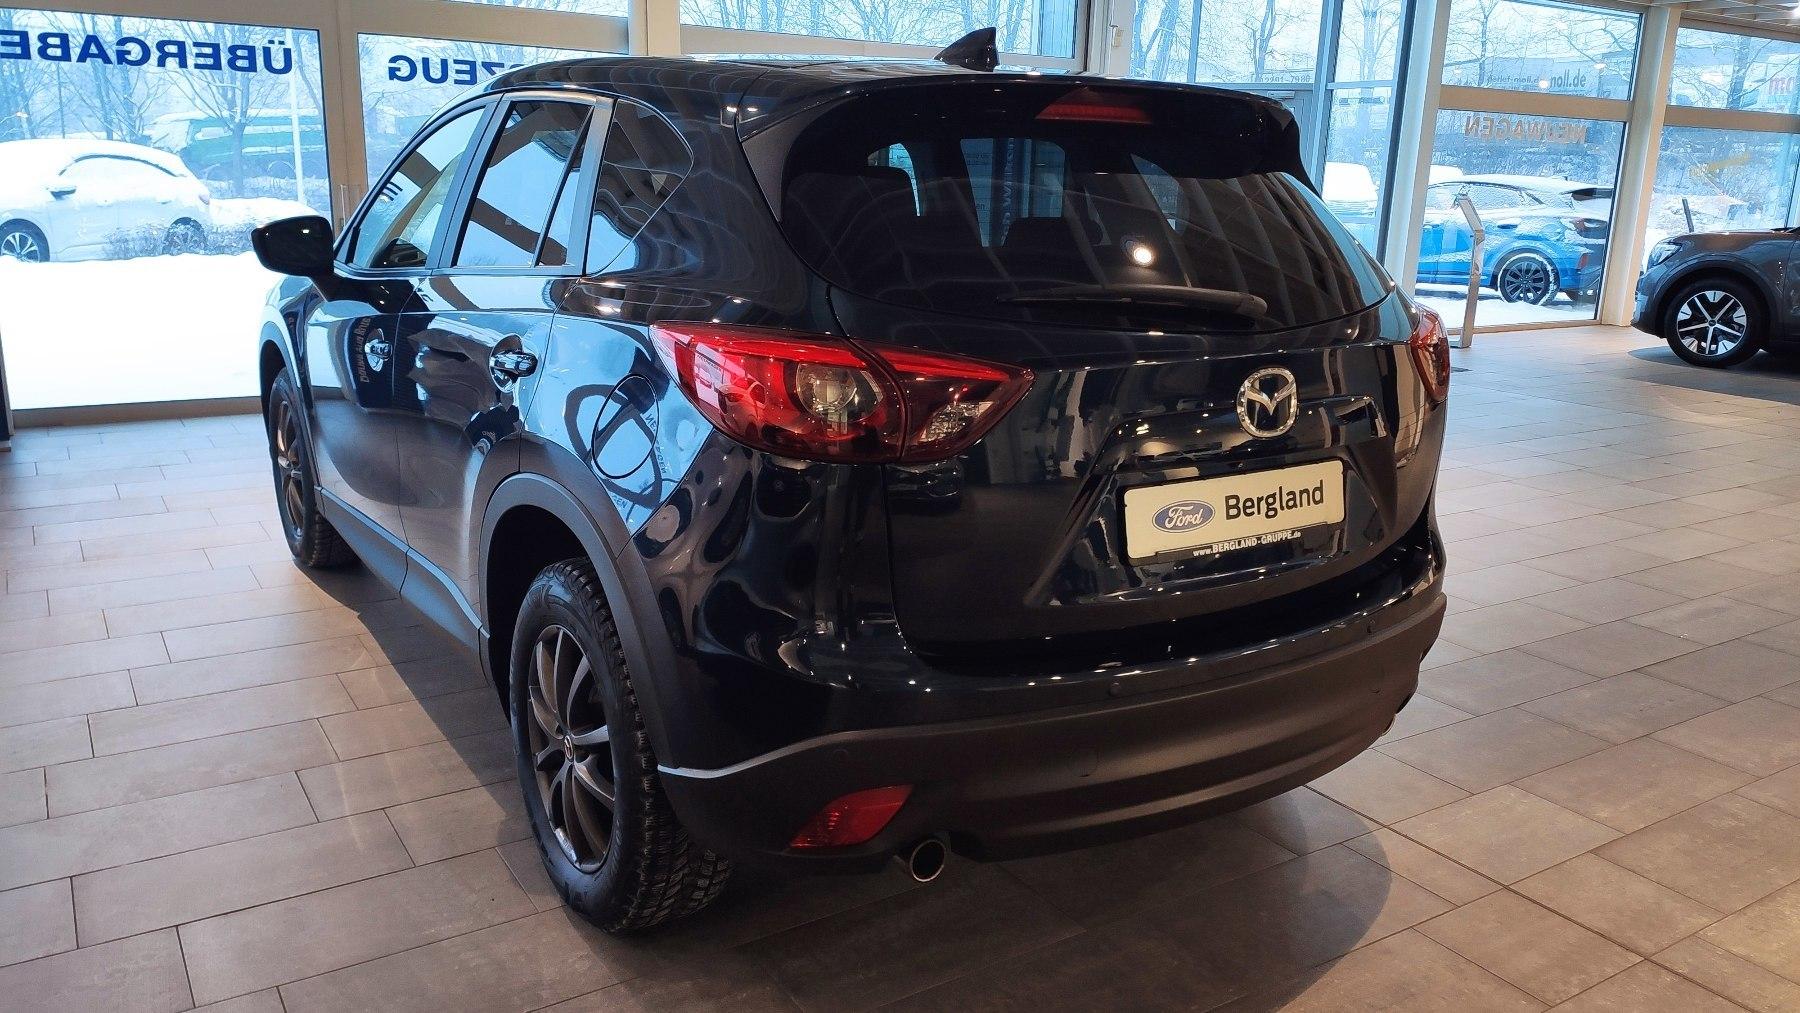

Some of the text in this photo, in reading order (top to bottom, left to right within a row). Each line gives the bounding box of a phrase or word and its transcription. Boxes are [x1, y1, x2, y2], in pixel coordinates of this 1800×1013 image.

[1165, 479, 1324, 529] Ford Bergland
[1193, 530, 1302, 557] www.BERGLAND-GRUPPE.de
